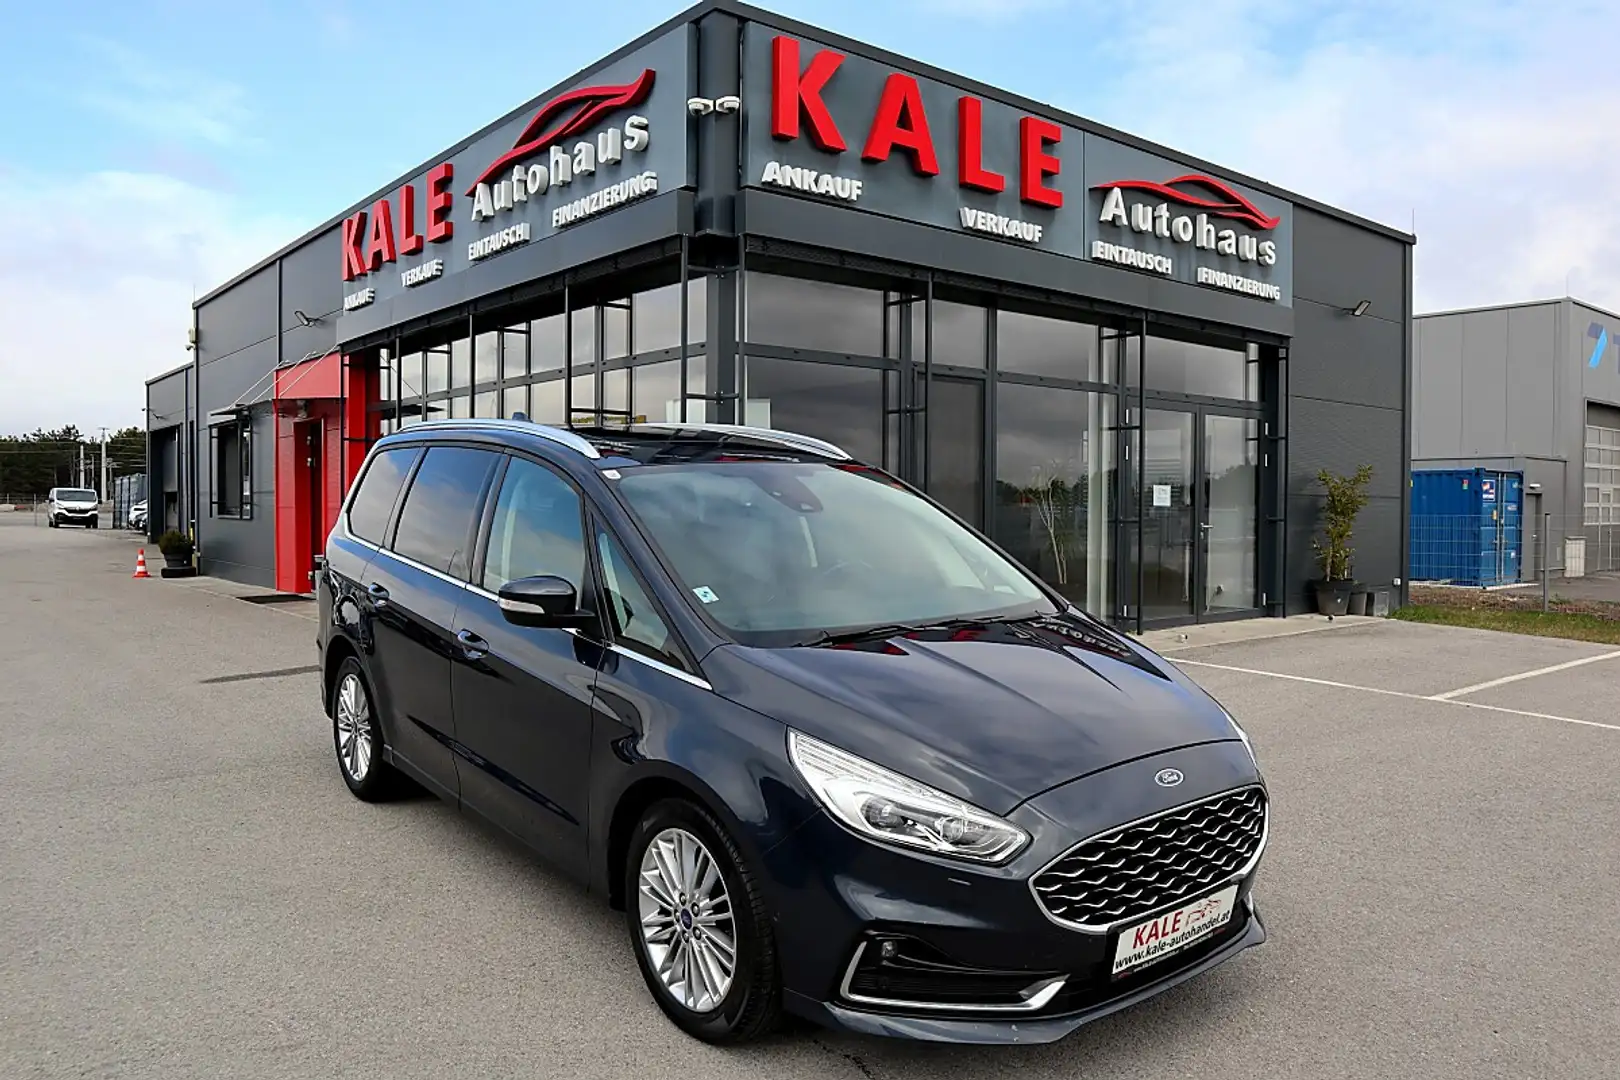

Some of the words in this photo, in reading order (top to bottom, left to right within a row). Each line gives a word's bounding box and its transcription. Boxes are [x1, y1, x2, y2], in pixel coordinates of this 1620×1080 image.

[771, 35, 1063, 208] KALE
[472, 114, 649, 222] Autohaus
[761, 160, 863, 201] ANKAUF
[342, 163, 453, 281] KALE
[552, 171, 657, 228] FINANZIERUNG
[468, 223, 530, 261] EINTAUSCH
[958, 206, 1042, 243] VERKAUF
[1099, 186, 1276, 267] Autohaus
[1092, 240, 1172, 275] EINTAUSCH
[1197, 267, 1280, 300] FINANZIERUNG
[1115, 909, 1230, 970] www.kale-autohandel.at
[1132, 910, 1184, 950] KALE
